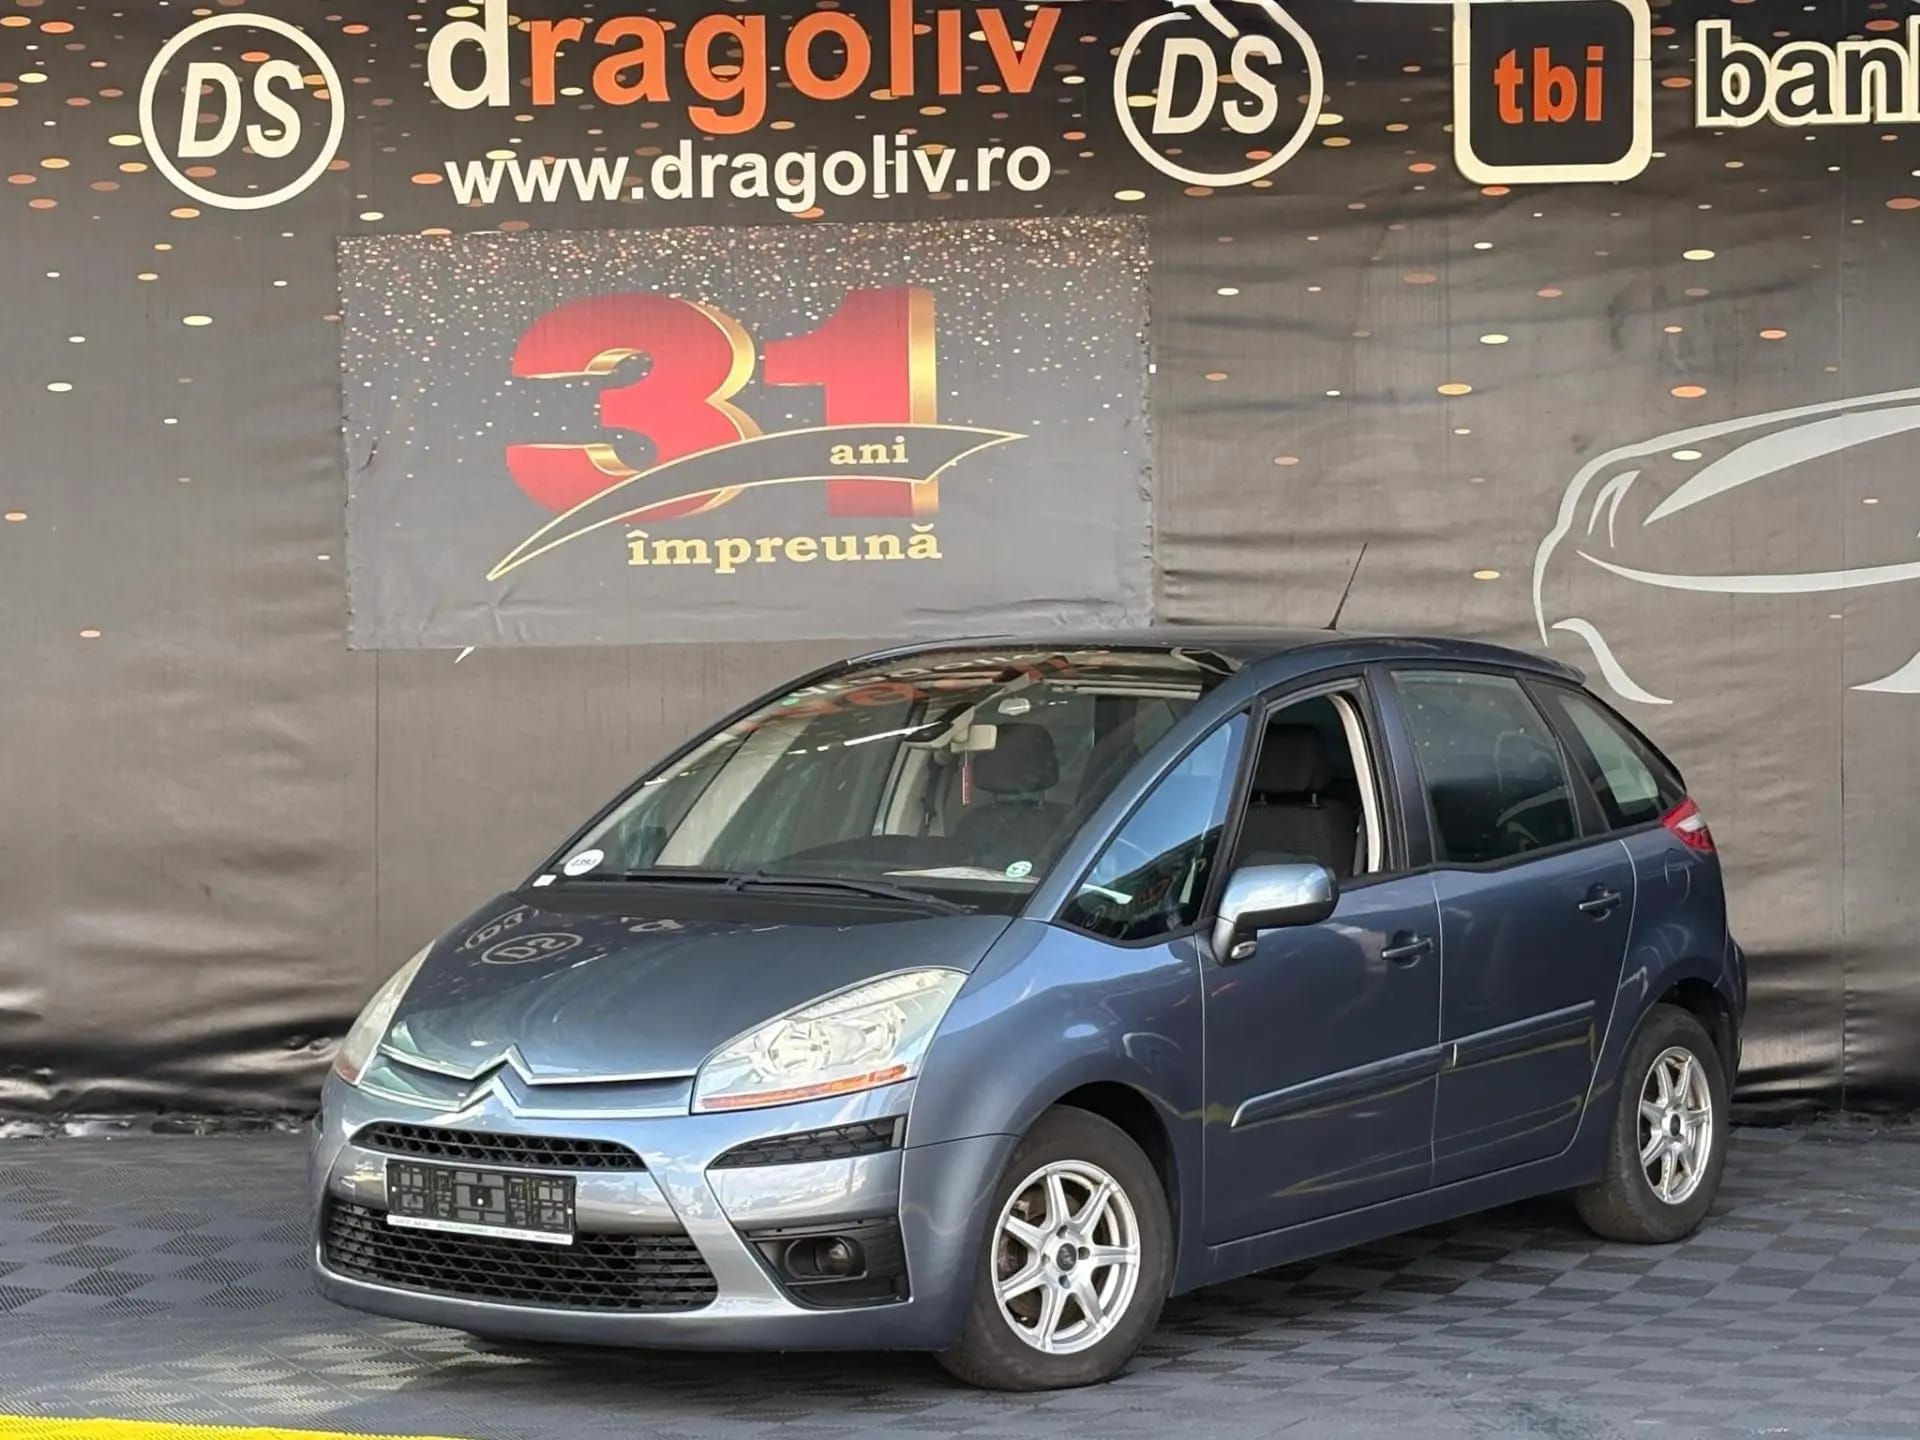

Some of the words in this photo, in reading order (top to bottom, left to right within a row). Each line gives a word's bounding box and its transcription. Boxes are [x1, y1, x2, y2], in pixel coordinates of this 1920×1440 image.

[177, 59, 305, 158] DS
[426, 0, 1062, 135] dragoliv
[1152, 35, 1283, 135] DS
[1493, 46, 1604, 123] tbi
[444, 134, 1052, 213] www.dragoliv.ro
[505, 286, 940, 519] 31
[829, 435, 909, 465] ani
[626, 522, 943, 575] împreună
